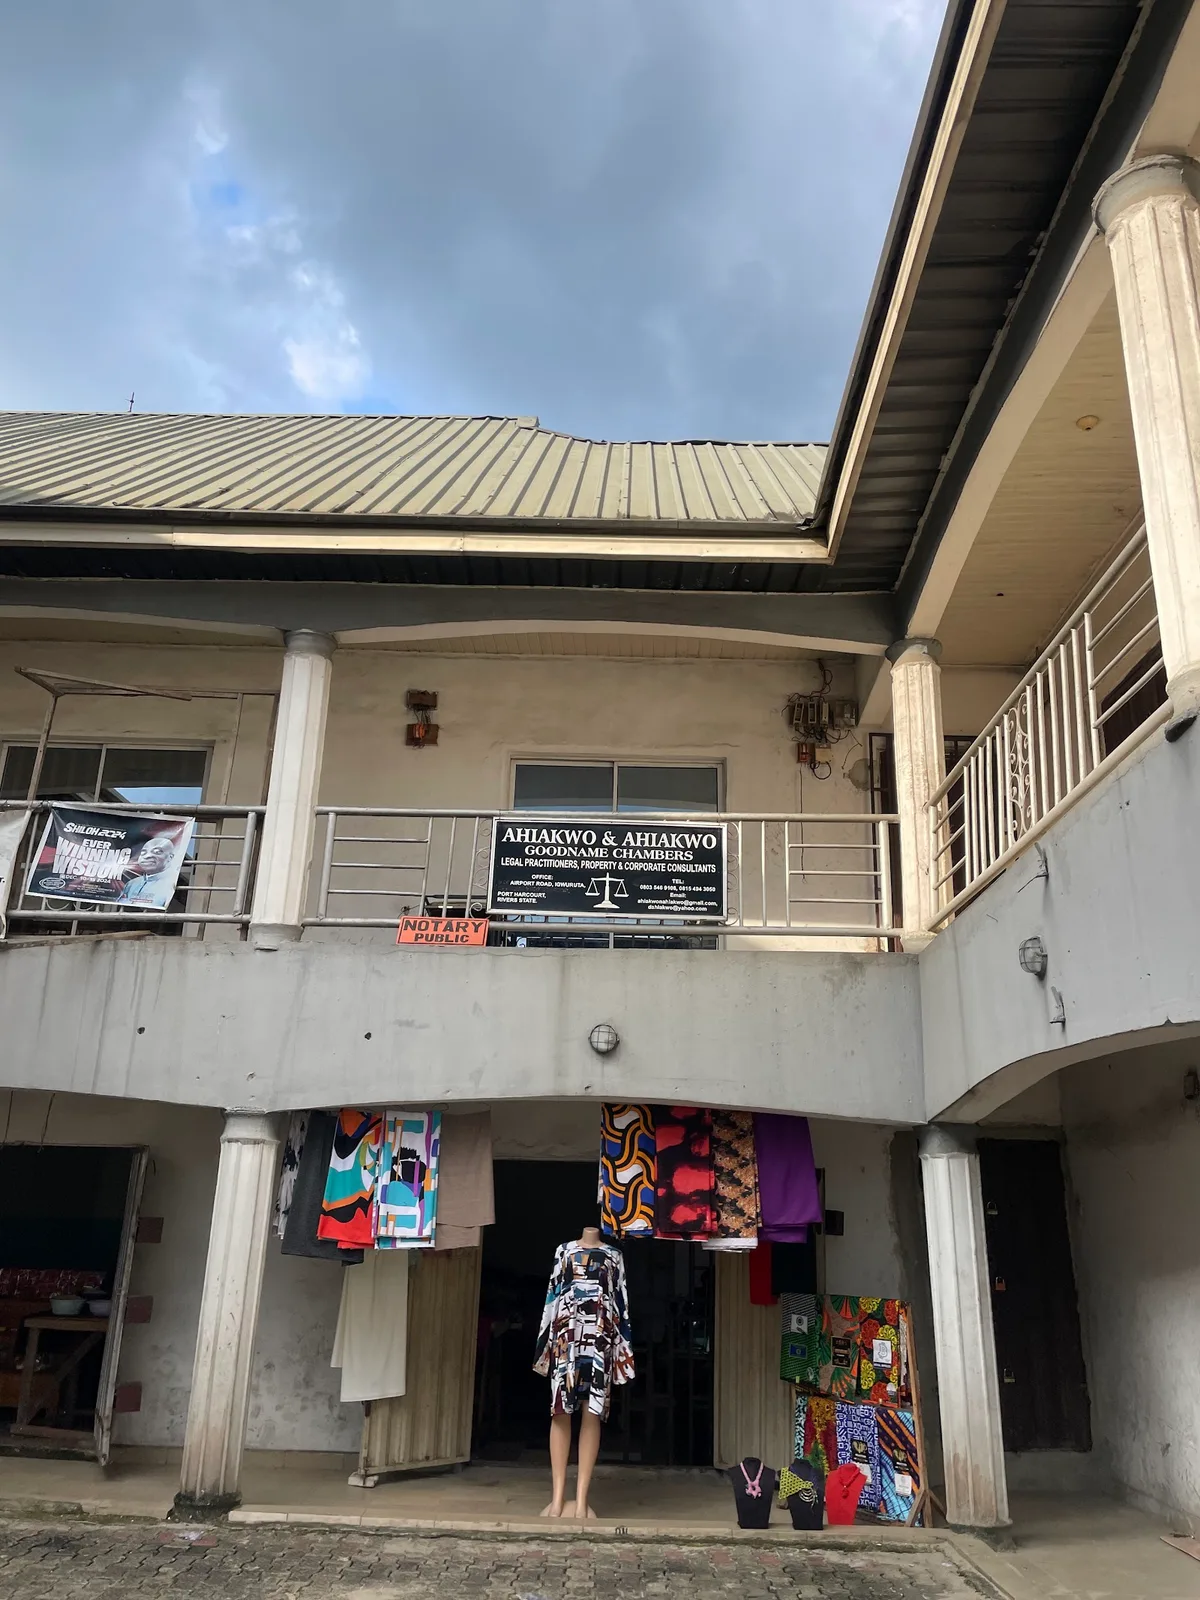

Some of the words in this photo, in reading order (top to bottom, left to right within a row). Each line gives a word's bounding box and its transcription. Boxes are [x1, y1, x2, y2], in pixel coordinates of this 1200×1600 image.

[63, 822, 100, 836] SHILOH
[98, 829, 127, 840] 2024
[501, 827, 597, 845] AHIAKWO
[601, 830, 619, 846] &
[621, 831, 717, 849] AHIAKWO
[55, 835, 132, 865] WINNING
[82, 838, 112, 850] EVER
[524, 844, 609, 859] GOODNAME
[612, 847, 694, 861] CHAMBERS
[52, 854, 124, 881] WISDOM
[500, 856, 523, 867] LEGAL
[524, 858, 580, 870] PRACTITIONERS,
[580, 860, 617, 870] PROPERTY
[618, 861, 624, 871] &
[624, 862, 666, 873] CORPORATE
[667, 863, 717, 874] CONSULTANTS
[513, 891, 547, 899] HARCOURT,
[403, 919, 484, 933] NOTARY
[413, 932, 469, 943] PUBLIC
